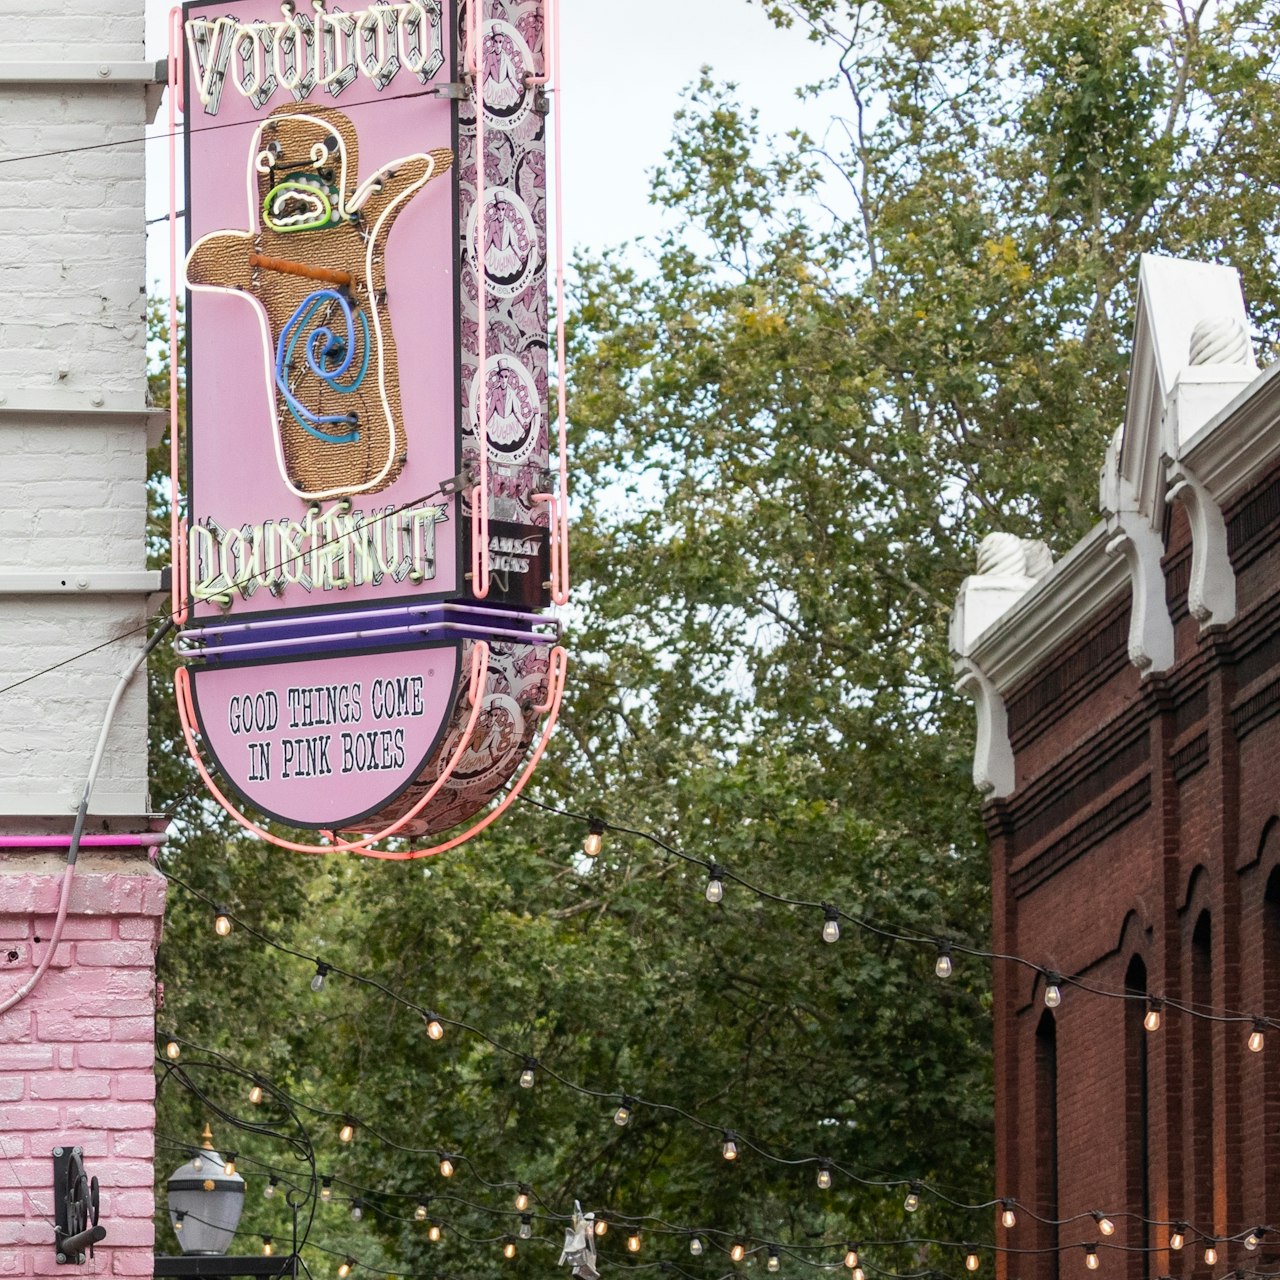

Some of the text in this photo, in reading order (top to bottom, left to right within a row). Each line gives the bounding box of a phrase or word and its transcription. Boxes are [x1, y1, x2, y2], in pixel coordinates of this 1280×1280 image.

[484, 535, 542, 556] AMSAY
[229, 676, 423, 734] GOOD THINGS COME
[248, 729, 405, 781] IN PINK BOXES
